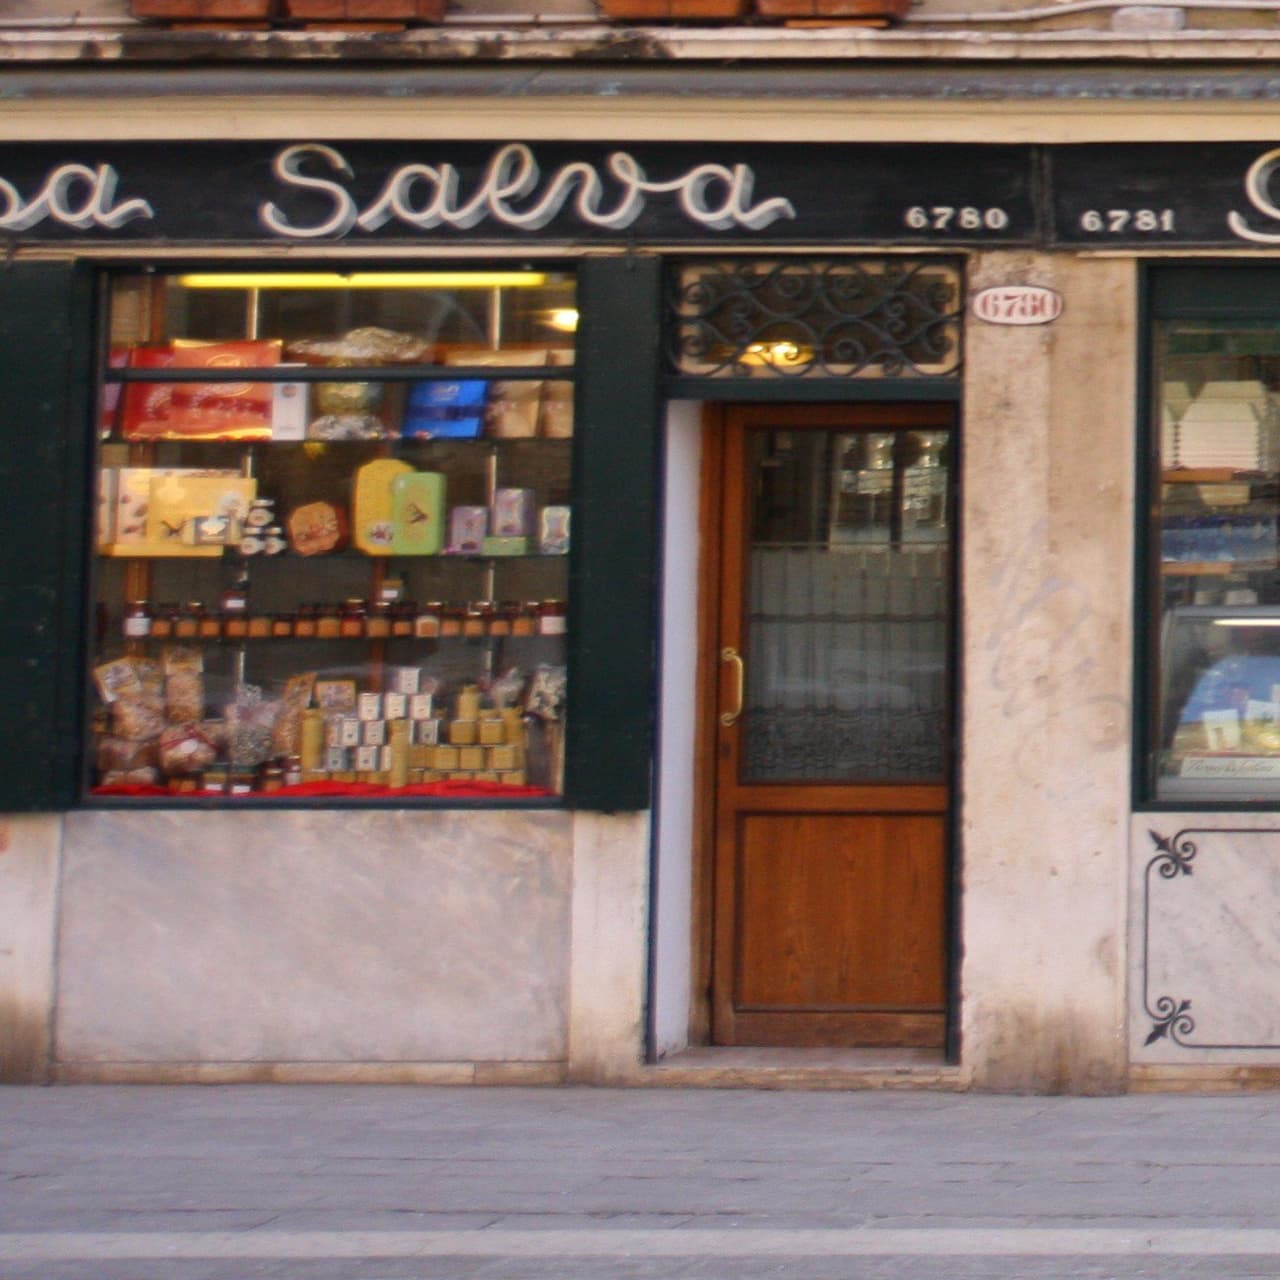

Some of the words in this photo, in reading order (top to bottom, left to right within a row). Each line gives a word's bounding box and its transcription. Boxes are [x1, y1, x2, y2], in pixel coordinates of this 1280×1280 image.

[258, 143, 797, 238] Salva
[905, 205, 1009, 230] 6780
[1080, 208, 1175, 233] 6781
[981, 293, 1059, 318] 6780
